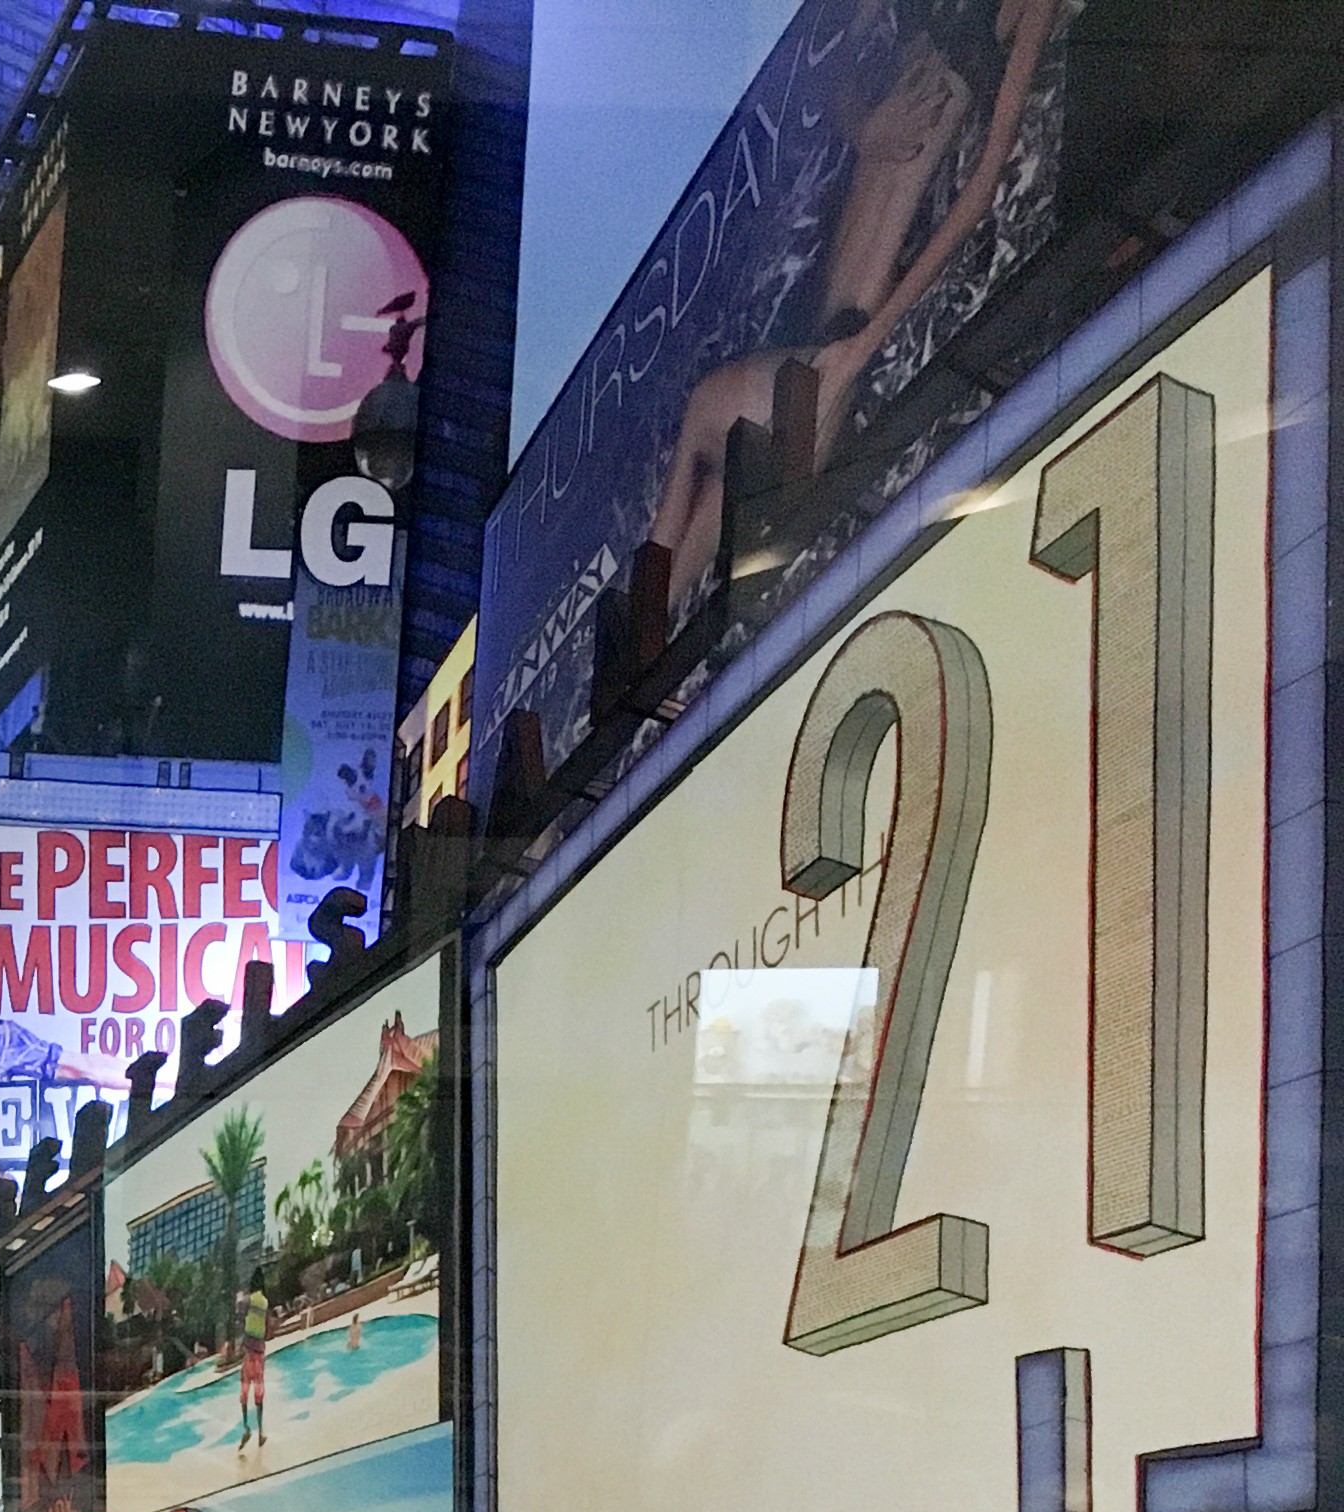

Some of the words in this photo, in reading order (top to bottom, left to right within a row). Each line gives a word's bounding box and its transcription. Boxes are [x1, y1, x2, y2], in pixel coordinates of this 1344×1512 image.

[231, 70, 432, 117] BARNEYS
[220, 468, 396, 587] LG
[646, 892, 820, 1053] THROUGH
[81, 1016, 144, 1057] FOR
